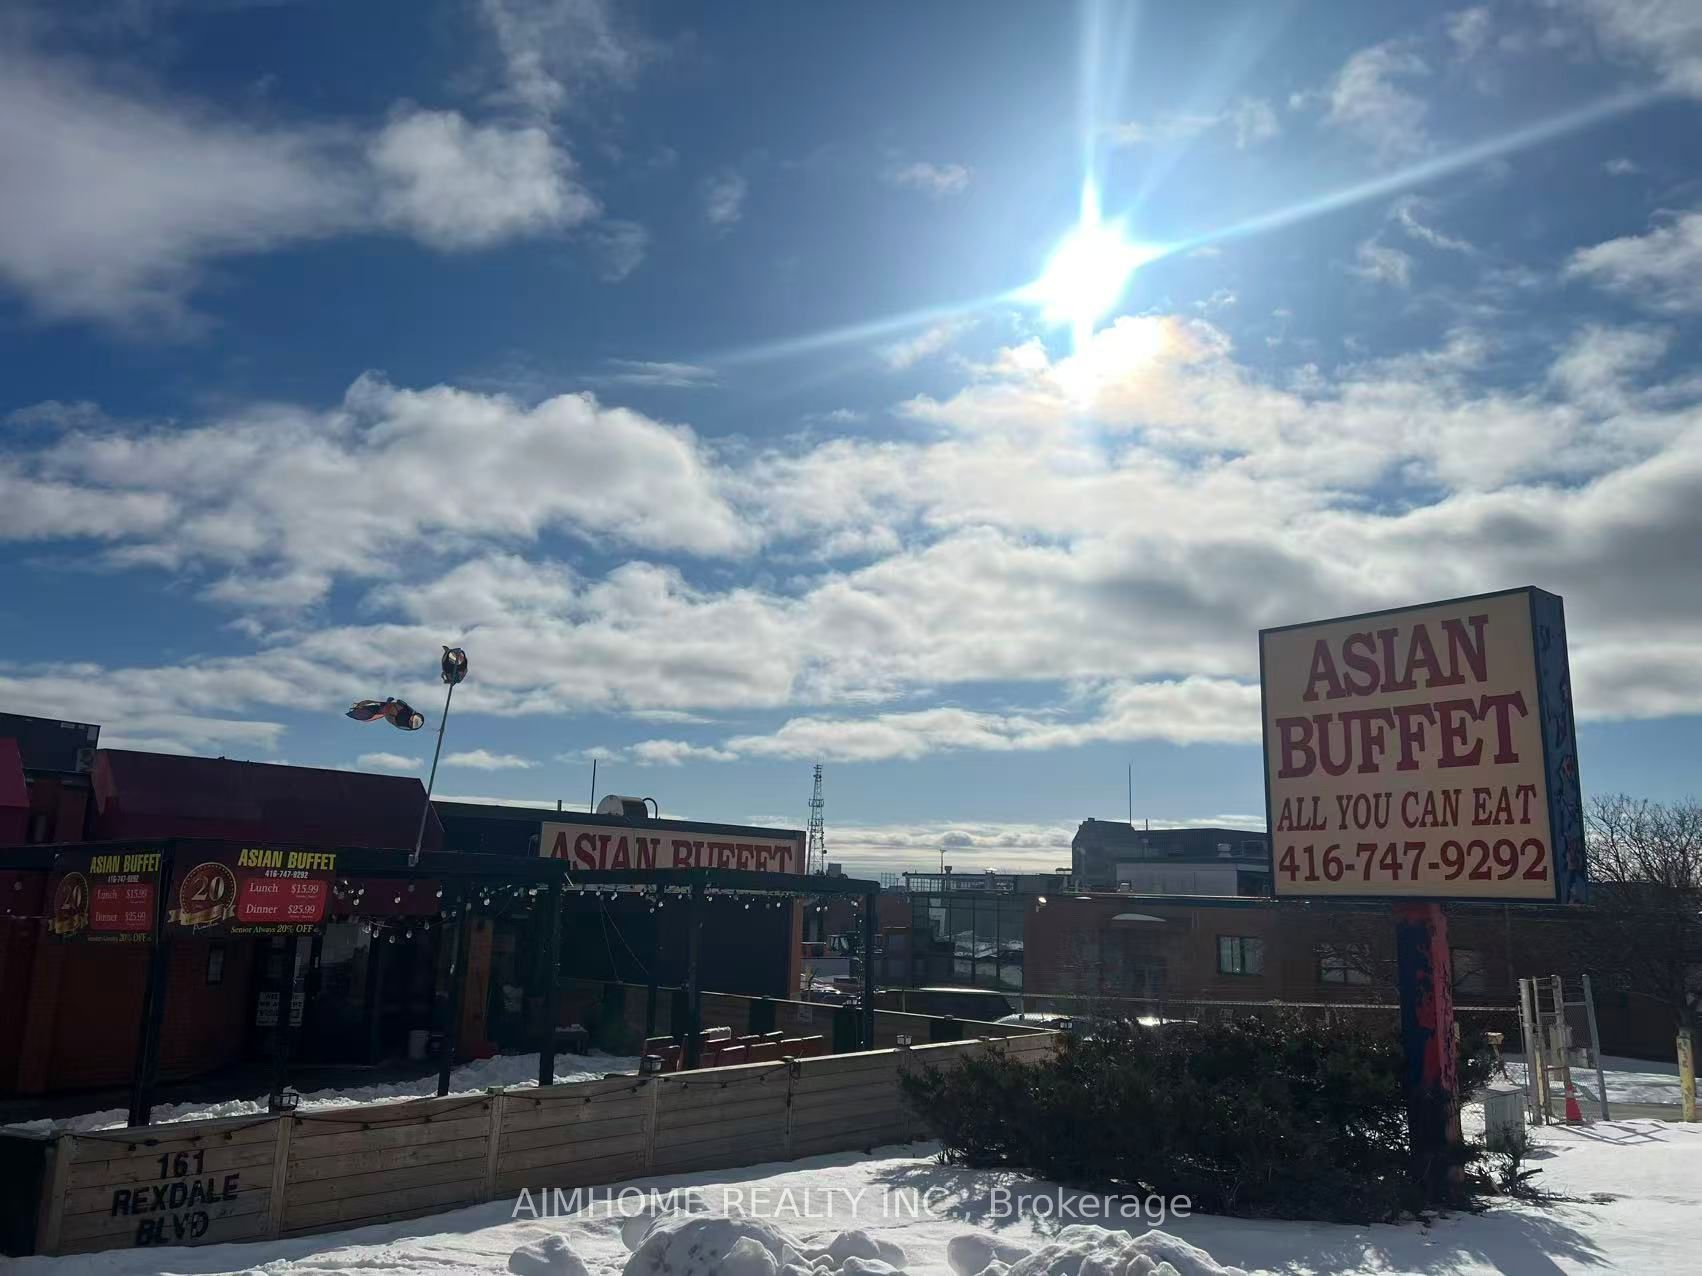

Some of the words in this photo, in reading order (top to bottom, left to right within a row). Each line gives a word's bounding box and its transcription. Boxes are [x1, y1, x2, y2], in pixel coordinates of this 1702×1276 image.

[1302, 614, 1489, 702] ASIAN
[1275, 691, 1529, 778] BUFFET
[1277, 796, 1327, 831] ALL
[1336, 792, 1392, 829] YOU
[1401, 788, 1462, 828] CAN
[1472, 784, 1537, 826] EAT
[89, 855, 121, 873] ASIAN
[123, 853, 161, 873] BUFFET
[238, 848, 283, 868] ASIAN
[288, 851, 337, 871] BUFFET
[551, 831, 661, 870] ASIAN
[671, 840, 793, 873] BUFFET
[1279, 838, 1547, 882] 416-747-9292
[191, 876, 225, 902] 20
[249, 882, 280, 893] Lunch
[290, 883, 319, 895] $15.99
[246, 903, 280, 915] Dinner
[287, 904, 316, 915] $25.99
[230, 926, 253, 934] Senior
[277, 924, 294, 934] 20%
[296, 924, 314, 934] OFF
[158, 1149, 205, 1179] 161
[112, 1173, 240, 1217] REXDALE
[136, 1211, 209, 1246] BLVD
